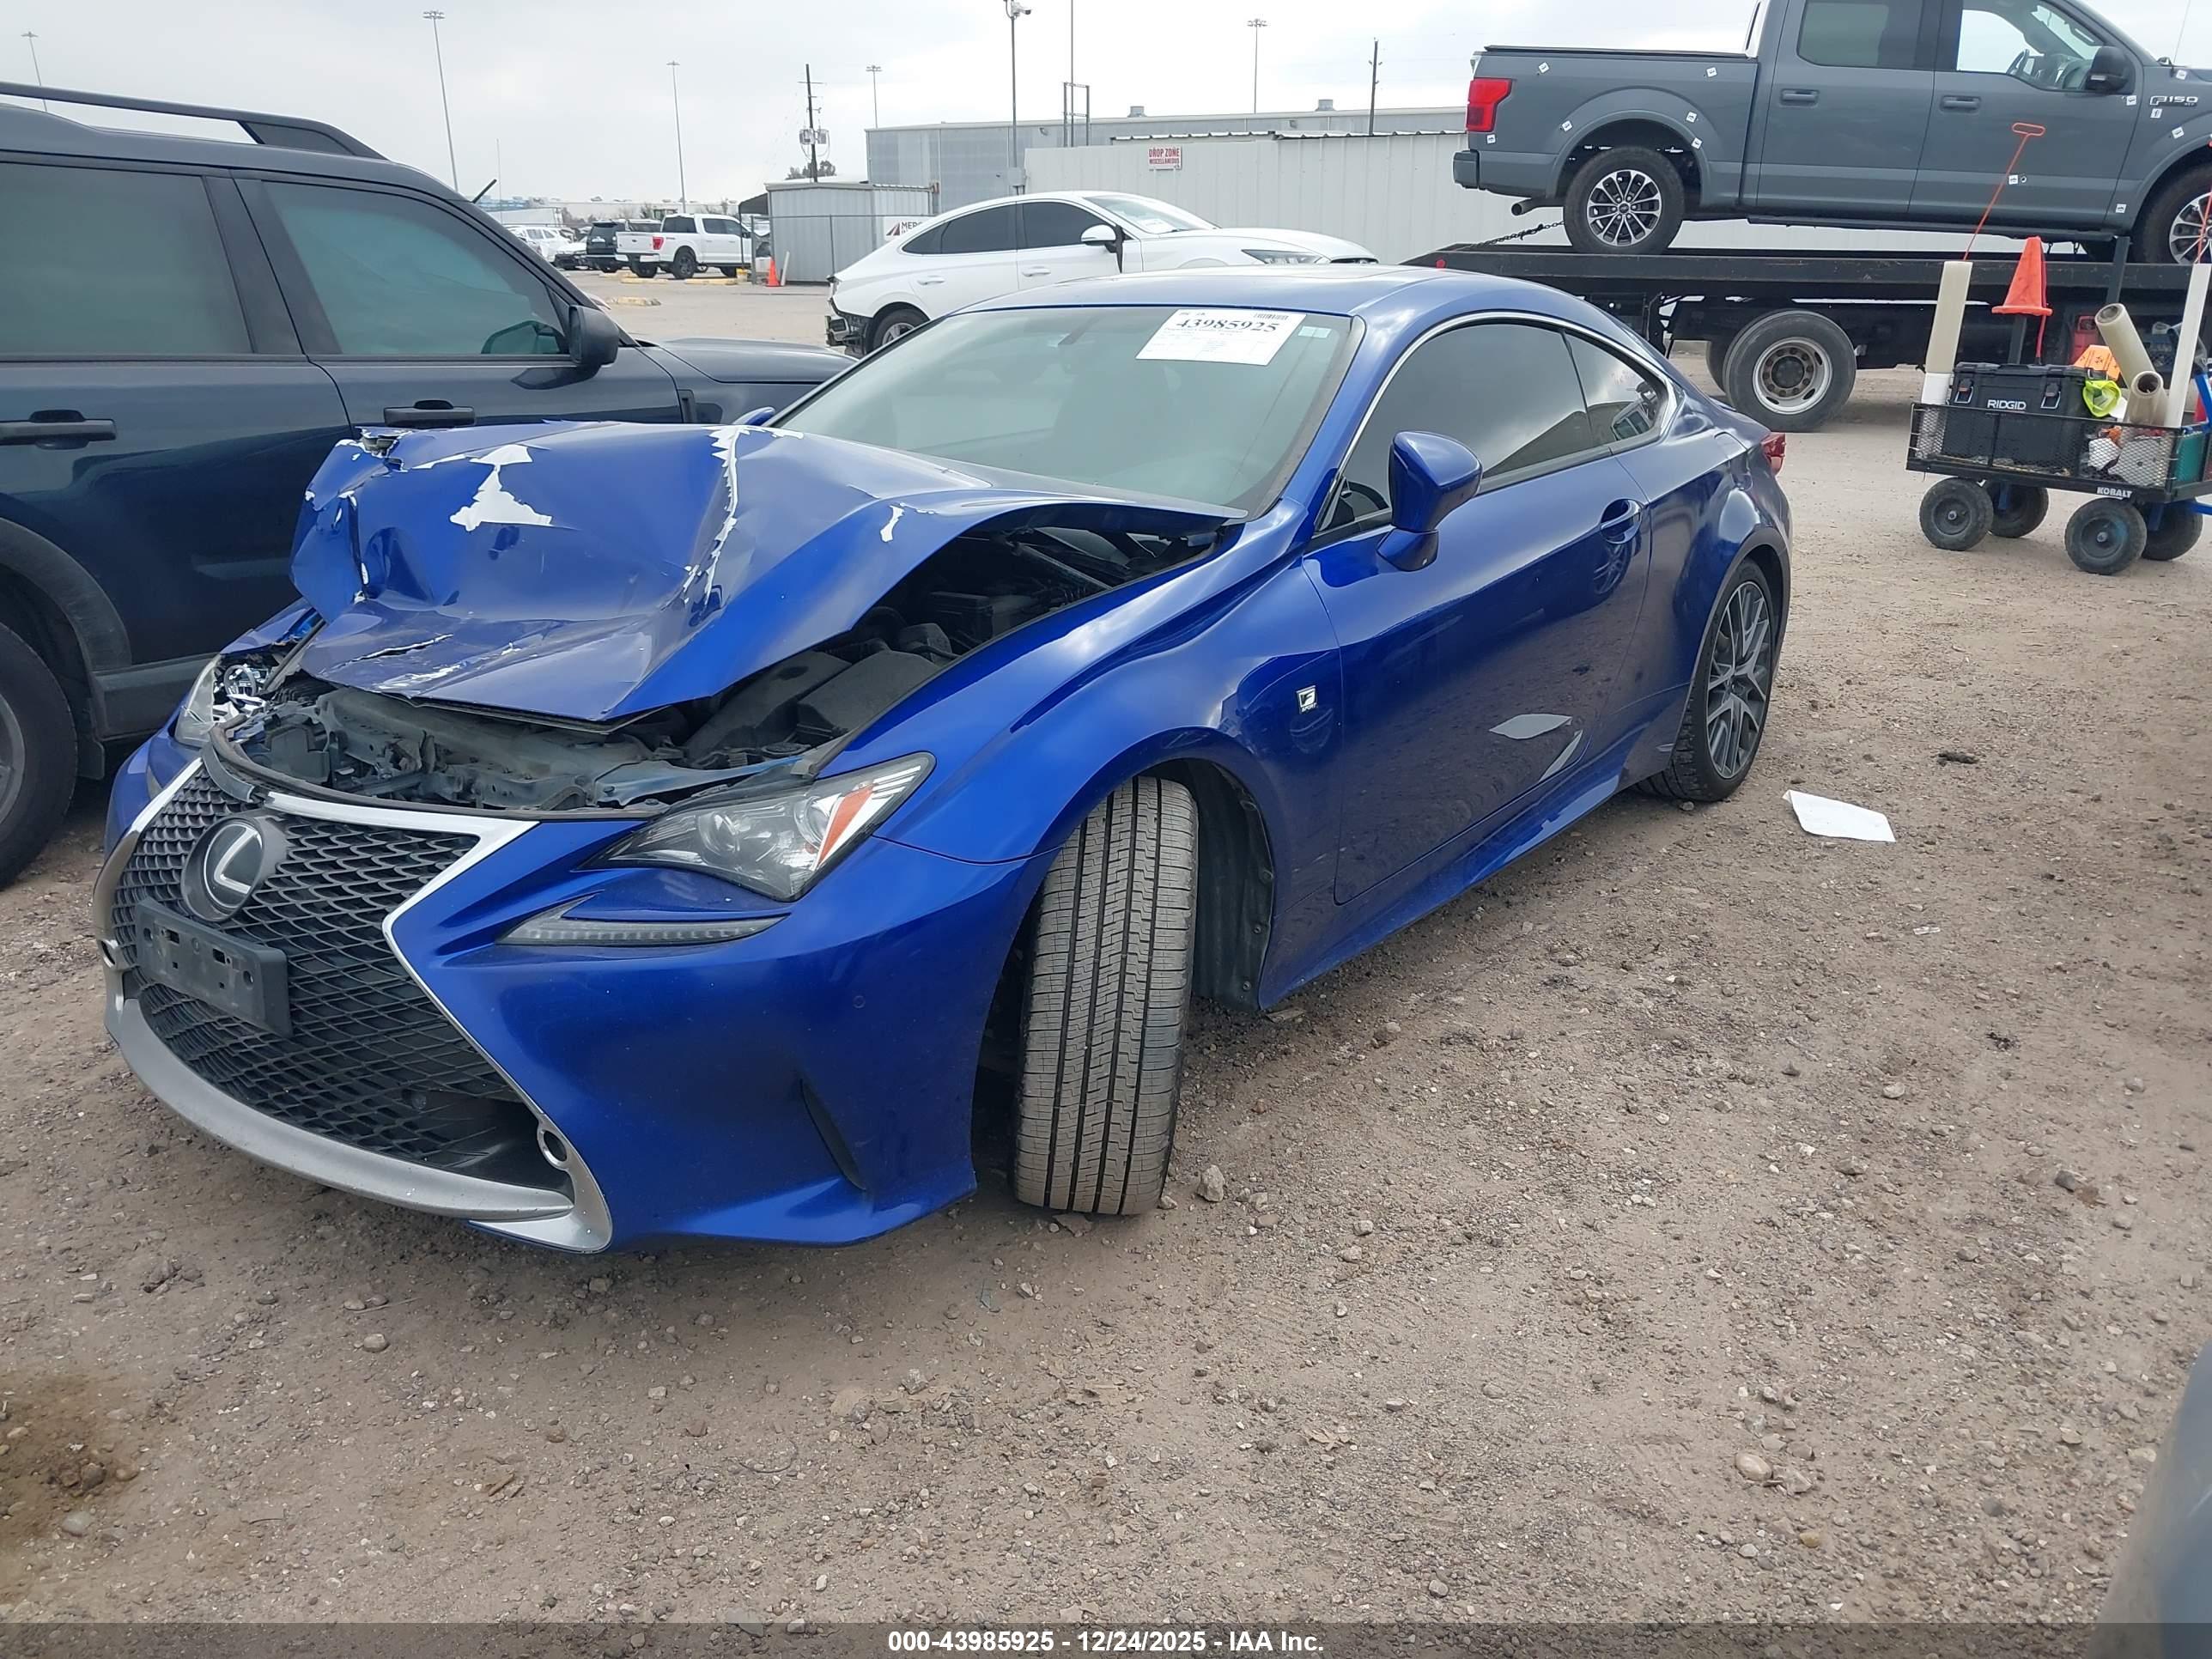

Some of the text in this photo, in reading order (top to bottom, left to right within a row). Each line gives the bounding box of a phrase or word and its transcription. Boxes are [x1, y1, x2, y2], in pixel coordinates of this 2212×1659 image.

[1148, 147, 1180, 158] DROP ZONE
[901, 222, 923, 230] MER
[1176, 318, 1280, 333] 43985925
[1986, 399, 2027, 410] RIDGID
[2096, 486, 2133, 498] KOBALT
